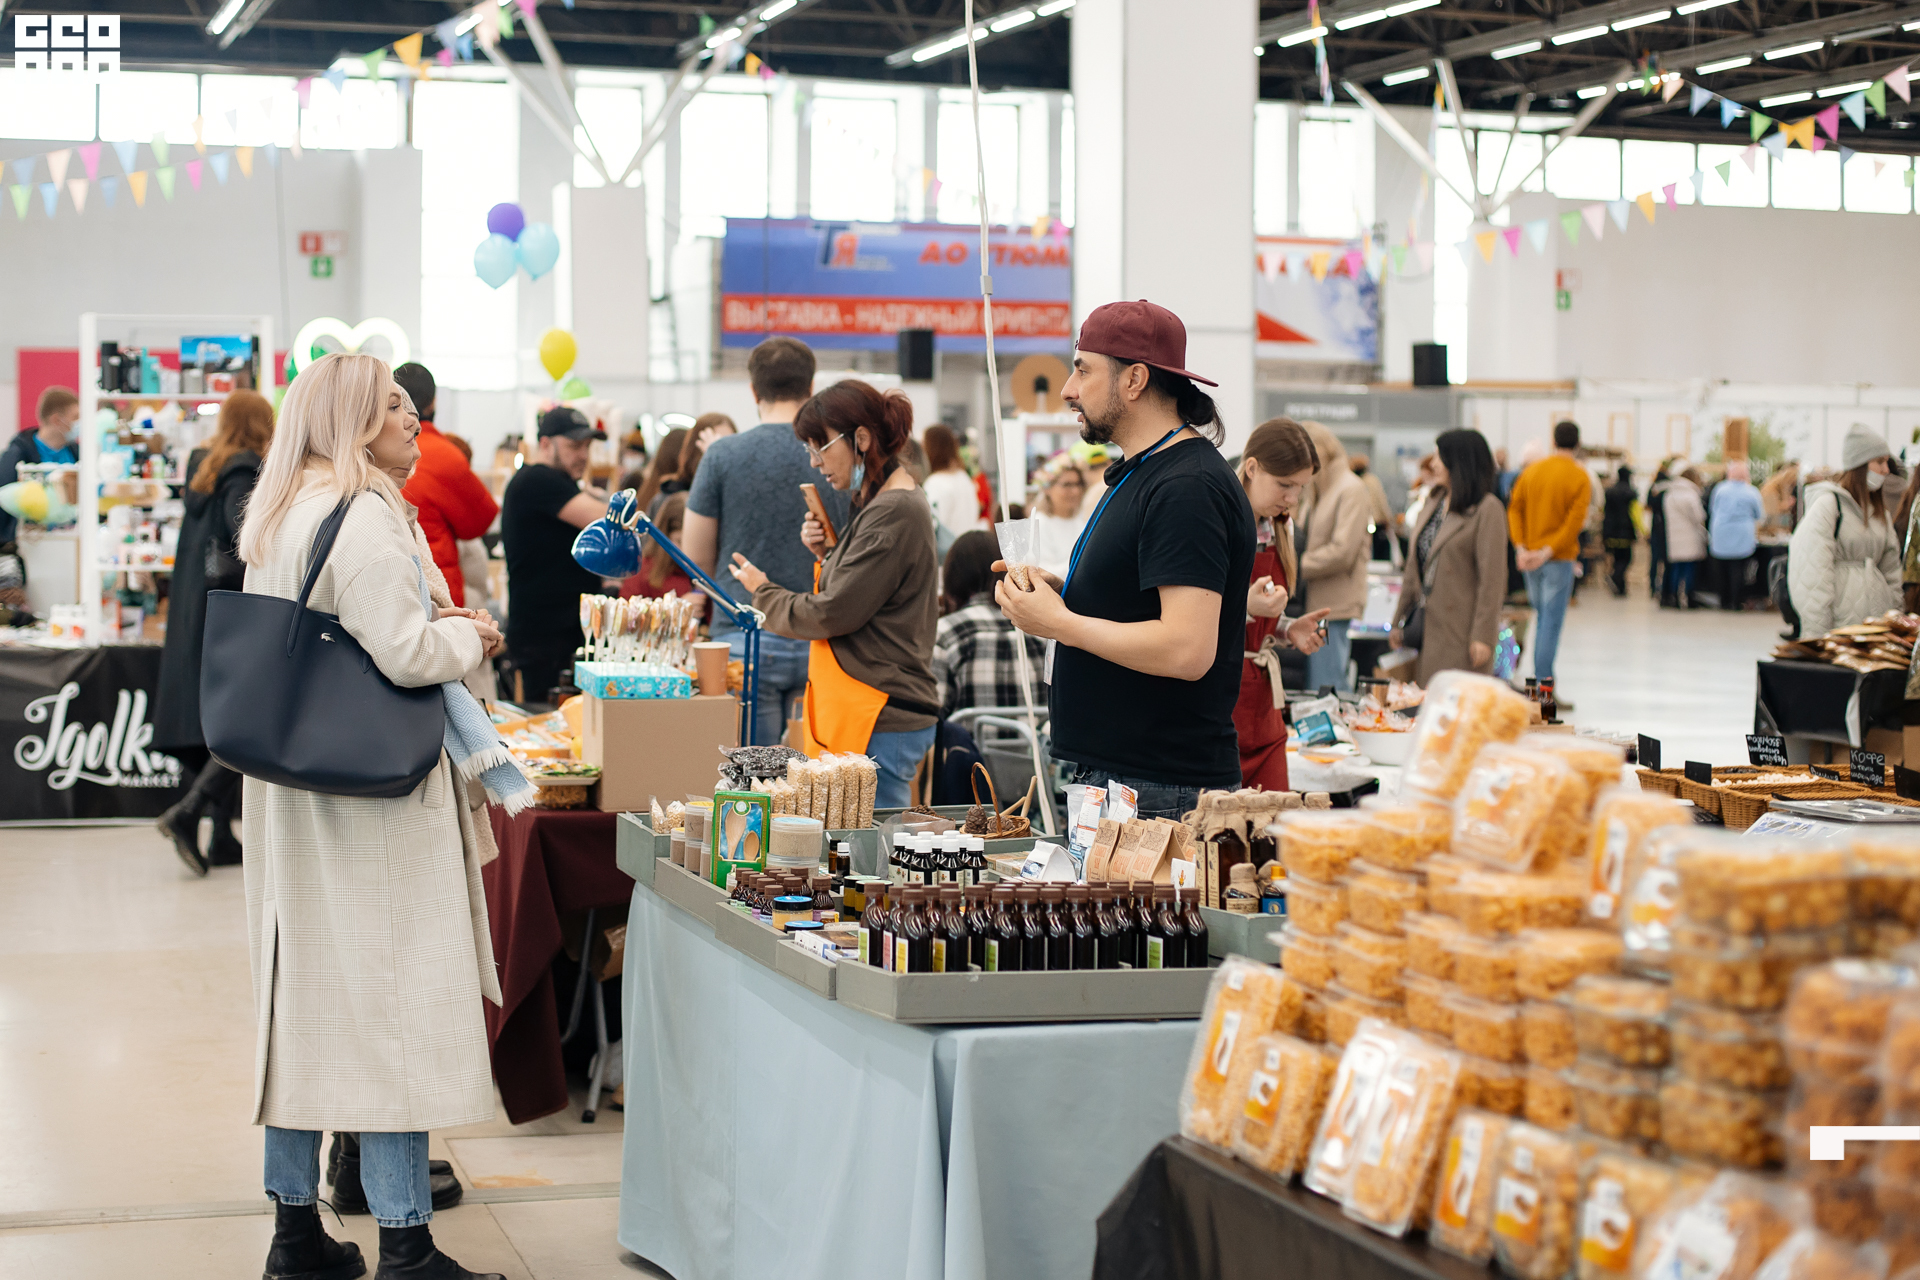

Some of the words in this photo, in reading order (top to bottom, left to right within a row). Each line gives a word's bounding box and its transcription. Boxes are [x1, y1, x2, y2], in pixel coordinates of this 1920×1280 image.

[919, 241, 969, 265] АО
[724, 299, 843, 331] ВЫСТАВКА
[856, 300, 977, 334] НАДЕЖНЫЙ
